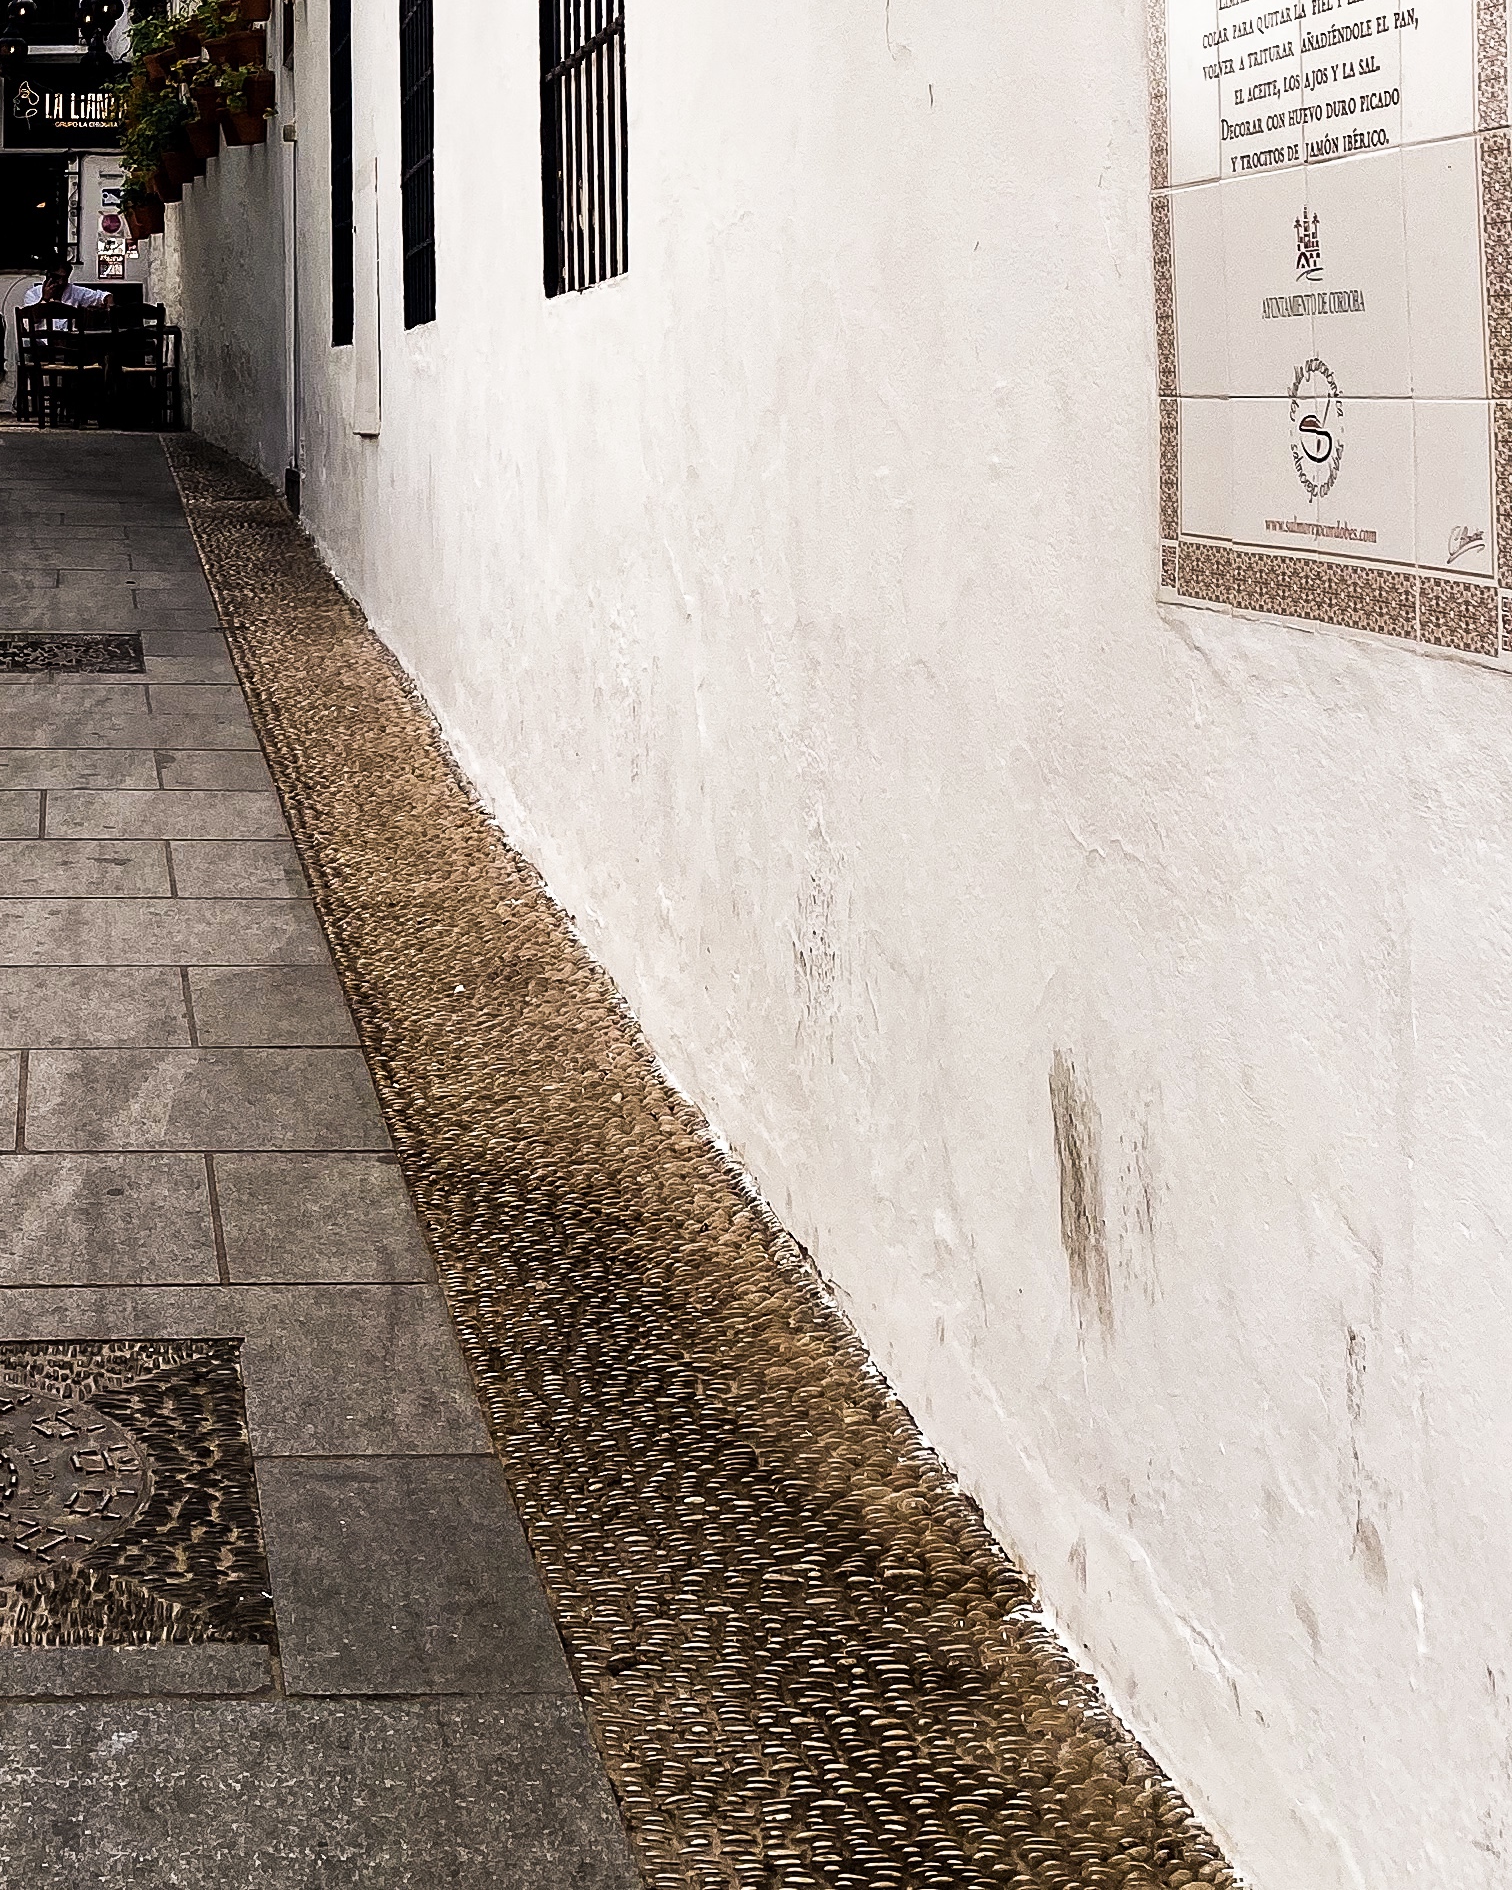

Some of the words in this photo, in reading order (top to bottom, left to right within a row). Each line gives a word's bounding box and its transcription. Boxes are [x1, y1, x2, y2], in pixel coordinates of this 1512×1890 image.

[1202, 28, 1229, 49] COLAR
[1232, 19, 1254, 39] PARA
[1257, 7, 1292, 34] QUITAR
[1294, 4, 1306, 21] LA
[1202, 59, 1235, 81] VOLVER
[1239, 55, 1245, 70] A
[1248, 41, 1294, 68] TRITURAR
[1300, 20, 1372, 53] AÑADIÉNDOLE
[1376, 16, 1389, 34] EL
[1393, 8, 1418, 30] PAN,
[1234, 88, 1244, 105] EL
[1247, 80, 1280, 100] ACEITE,
[1283, 74, 1300, 92] LOS
[1304, 67, 1328, 91] AJOS
[1331, 64, 1338, 82] Y
[1343, 62, 1355, 79] LA
[1359, 56, 1380, 75] SAL.
[45, 93, 63, 119] LA
[1221, 118, 1264, 141] DECORAR
[1267, 112, 1285, 131] CON
[1288, 105, 1322, 126] HUEVO
[1326, 98, 1356, 119] DURO
[1360, 88, 1399, 112] PICADO
[1231, 155, 1237, 172] Y
[1240, 147, 1284, 170] TROCITOS
[1287, 144, 1299, 161] DE
[1304, 133, 1338, 163] JAMÓN
[1343, 128, 1389, 152] IBÉRICO.
